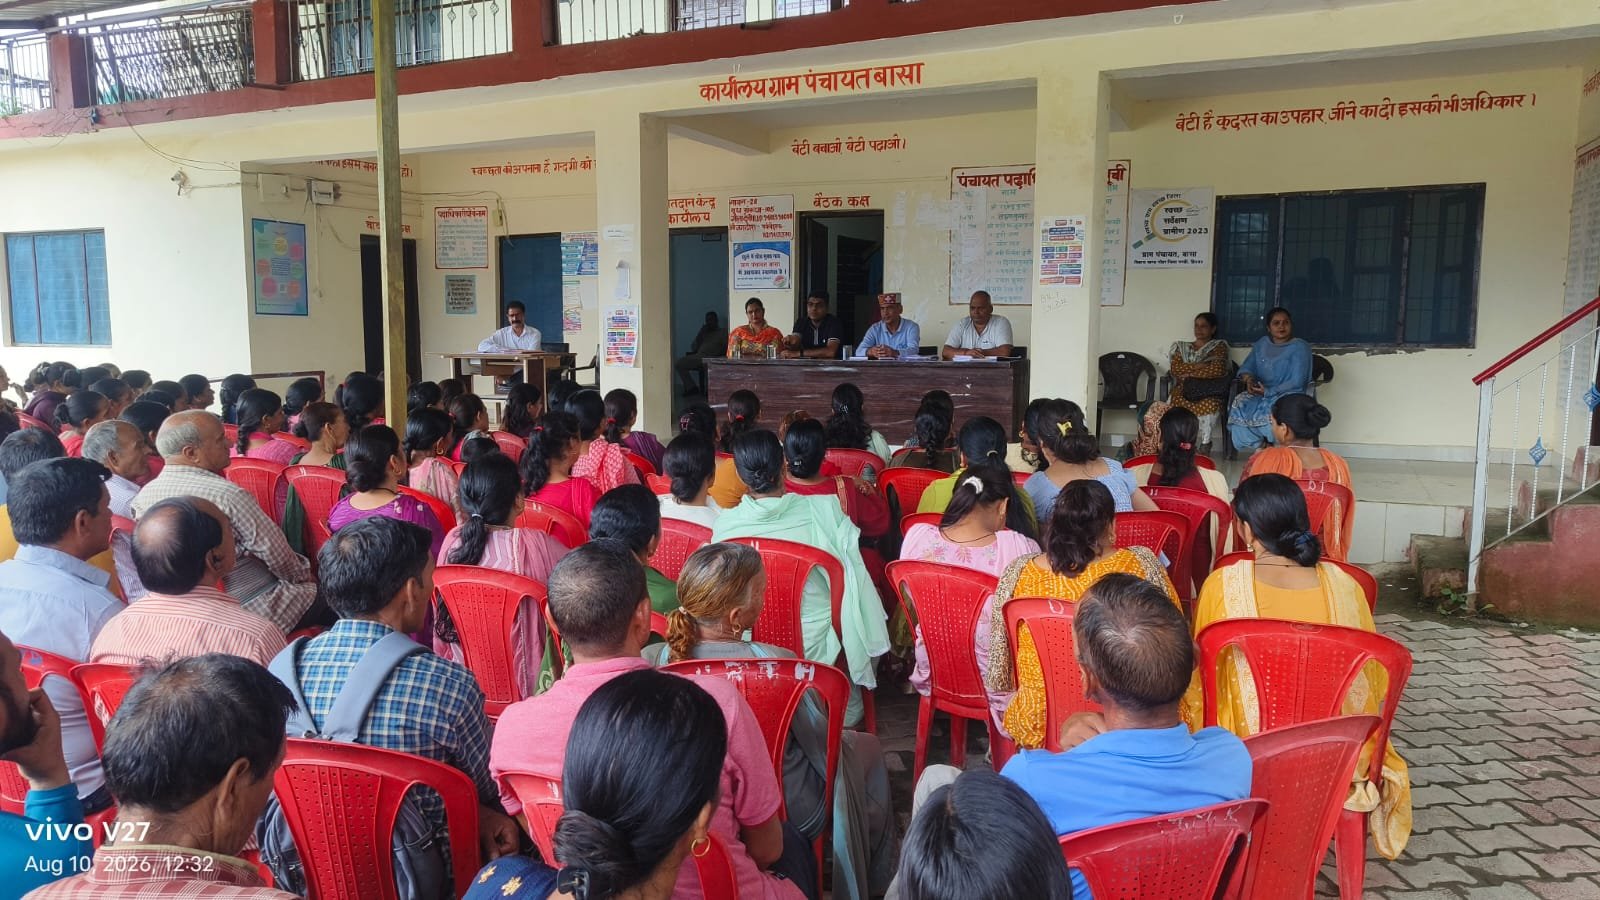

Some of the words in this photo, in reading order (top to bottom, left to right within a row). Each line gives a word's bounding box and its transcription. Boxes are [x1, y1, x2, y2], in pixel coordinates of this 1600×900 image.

[700, 75, 768, 101] कार्यालय
[768, 75, 802, 97] ग्राम
[803, 68, 873, 93] पंचायत
[873, 62, 925, 87] बासा
[1176, 112, 1200, 132] बेटी
[791, 138, 810, 156] बेटी
[845, 136, 866, 152] बेटी
[956, 172, 1000, 188] पंचायत
[813, 192, 843, 208] बैठक
[847, 195, 871, 208] कक्ष
[1162, 226, 1185, 235] ग्रामीण
